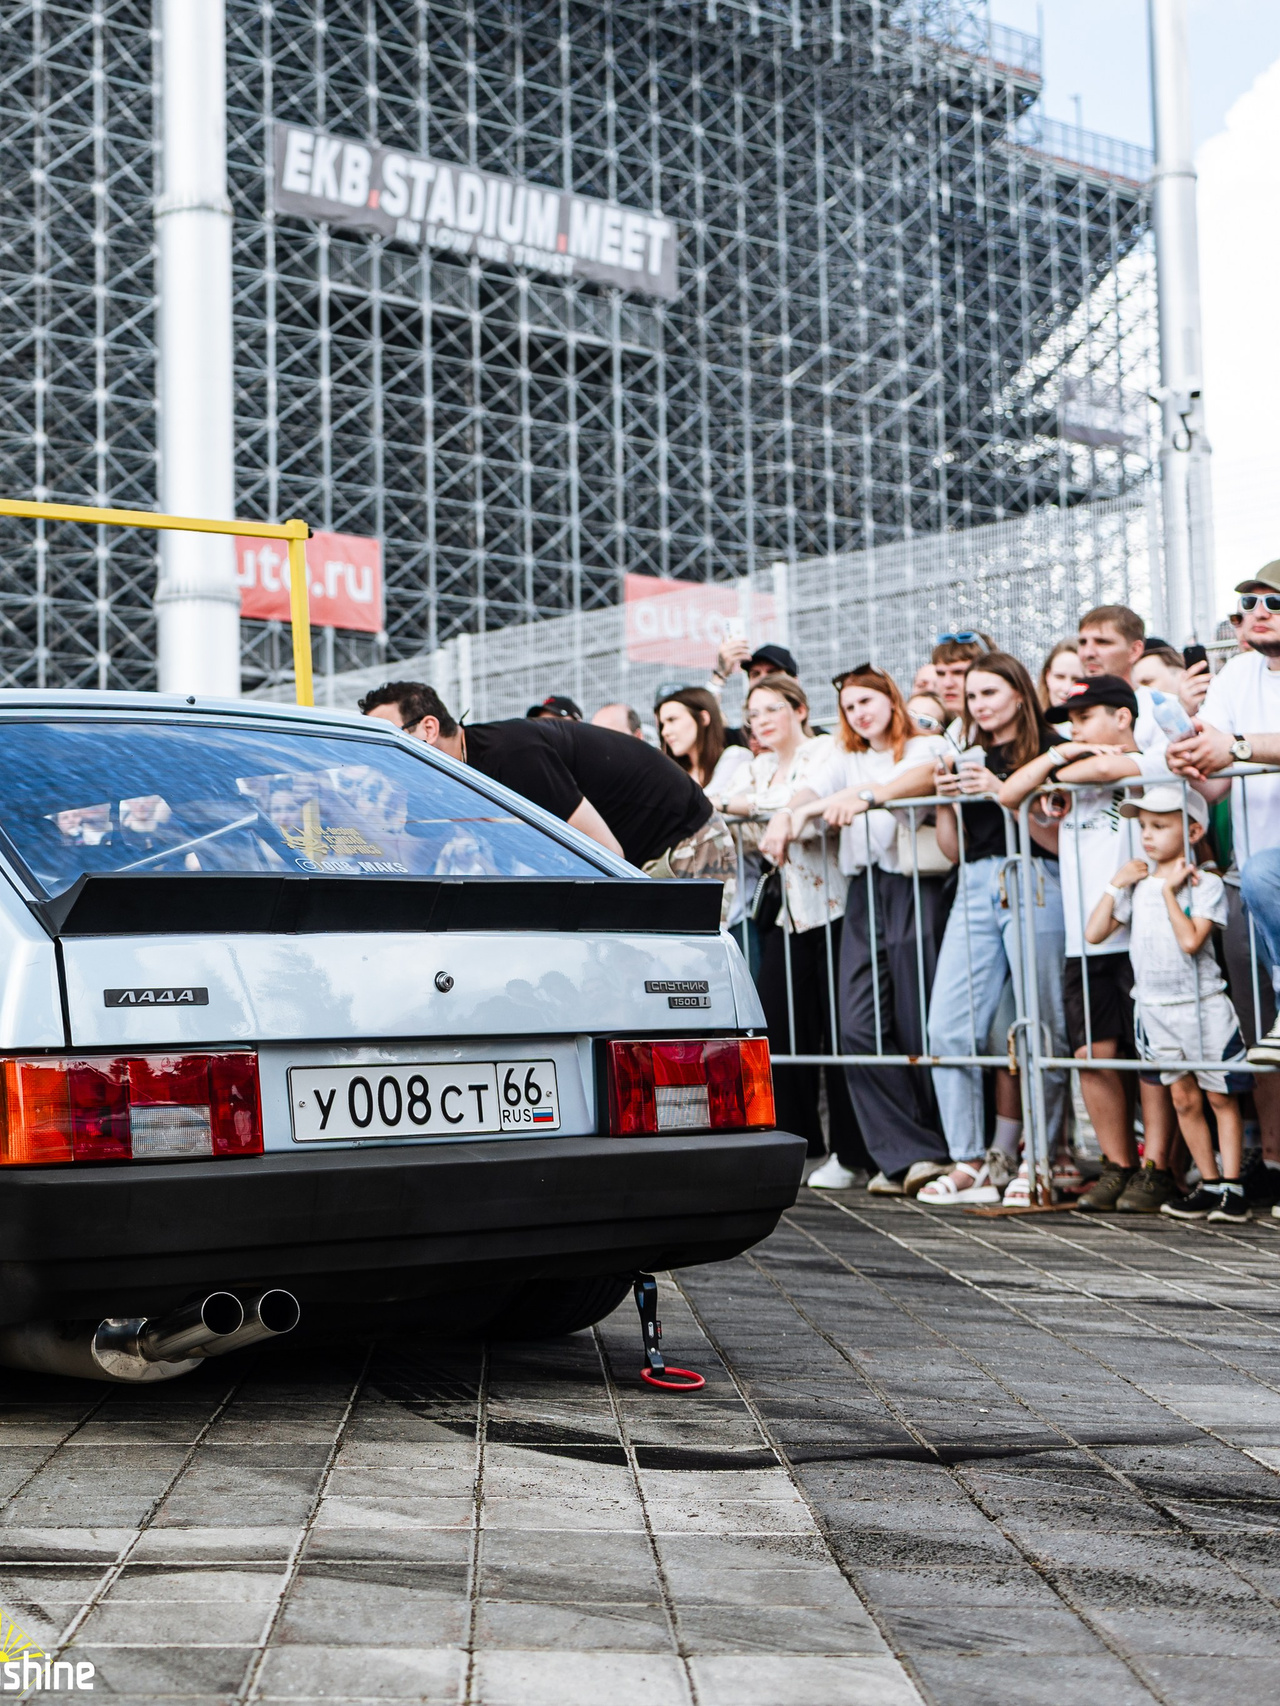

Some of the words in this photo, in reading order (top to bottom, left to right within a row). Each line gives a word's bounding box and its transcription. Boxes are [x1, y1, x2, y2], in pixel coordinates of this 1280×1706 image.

[282, 129, 671, 276] EKB.STADIUM.MEET
[396, 218, 420, 244] IN
[425, 223, 472, 254] LOW
[476, 235, 508, 263] WE
[513, 245, 576, 276] TRUST
[236, 545, 373, 602] ut.ru
[117, 989, 195, 1004] ЛАДА
[650, 981, 707, 991] СПУТНИК
[674, 998, 697, 1006] 1500
[503, 1067, 542, 1106] 66
[502, 1108, 532, 1123] RUS
